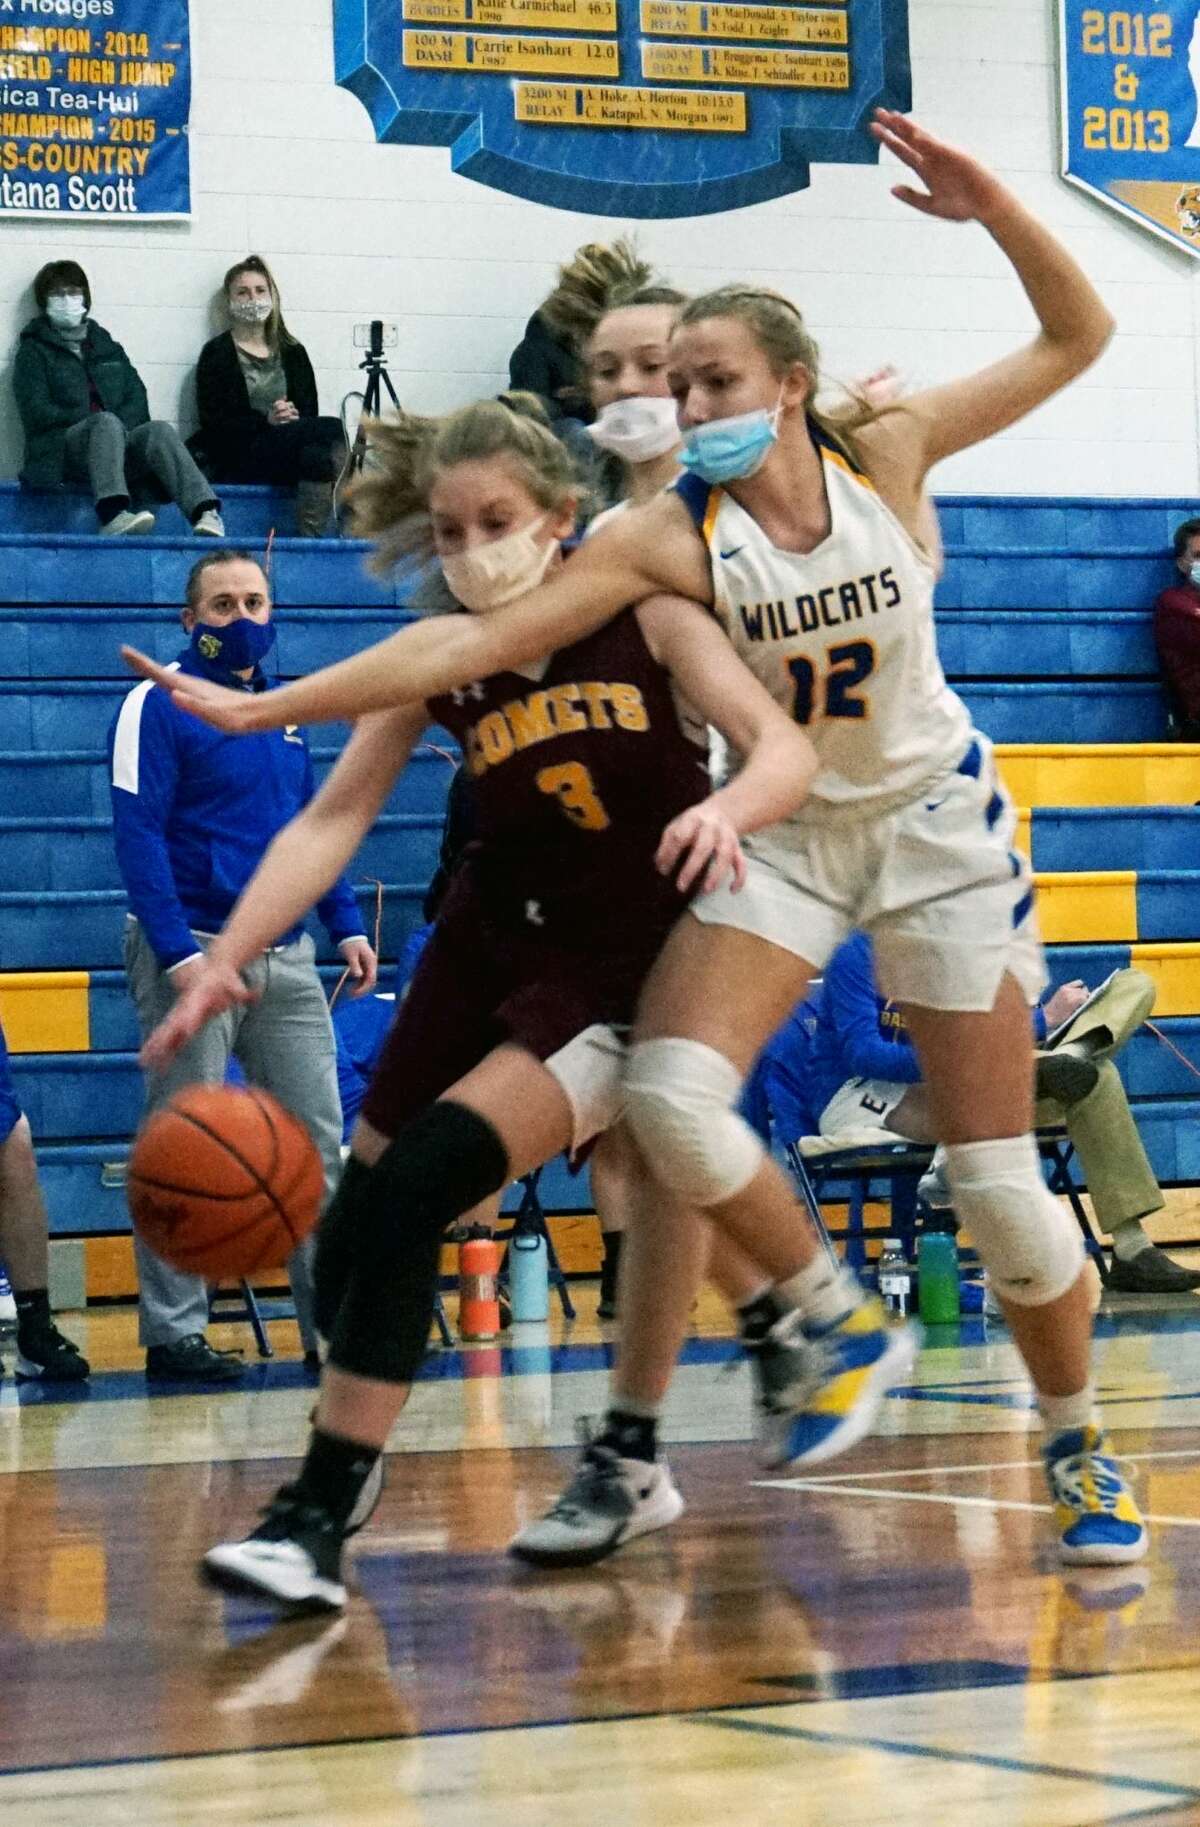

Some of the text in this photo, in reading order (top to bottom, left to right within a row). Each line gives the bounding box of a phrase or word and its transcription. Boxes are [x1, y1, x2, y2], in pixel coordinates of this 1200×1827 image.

[20, 0, 115, 19] Hodges
[104, 31, 149, 57] 2014
[475, 38, 513, 53] Carrie
[1081, 9, 1173, 58] 2012
[68, 57, 116, 84] HIGH
[120, 62, 176, 87] JUMP
[1113, 63, 1140, 101] &
[0, 84, 139, 113] ica Tea-Hui
[0, 112, 95, 140] HAMPION
[109, 118, 156, 142] 2015
[1083, 106, 1170, 152] 2013
[0, 141, 150, 175] S-COUNTRY
[0, 173, 138, 212] tana Scott
[740, 566, 902, 642] WILDCATS
[783, 636, 882, 726] 12
[536, 760, 611, 830] 3
